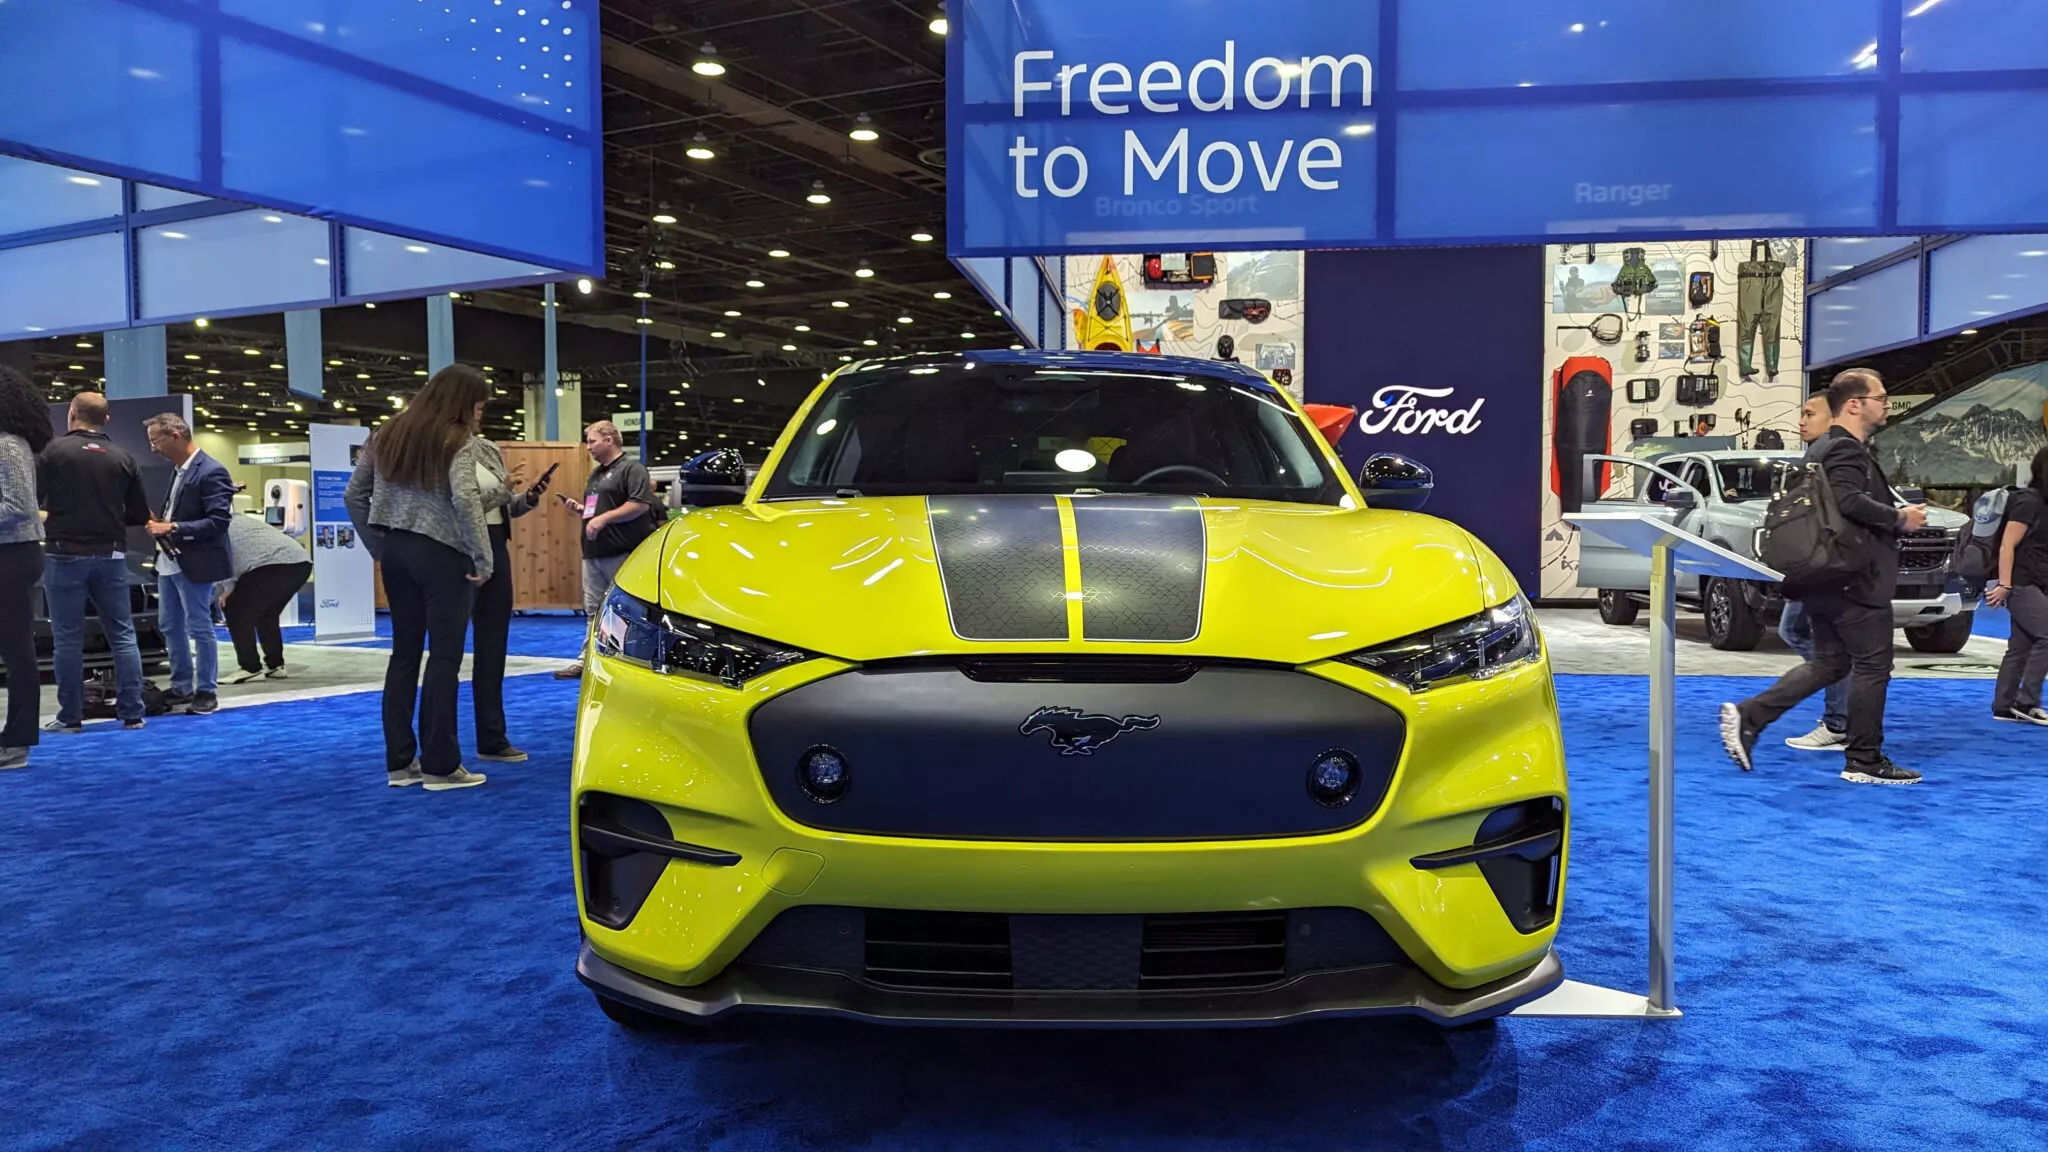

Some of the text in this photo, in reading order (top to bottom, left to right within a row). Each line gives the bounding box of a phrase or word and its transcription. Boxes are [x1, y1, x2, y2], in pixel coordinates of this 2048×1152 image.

[1013, 39, 1373, 117] Freedom
[1008, 127, 1342, 198] to Move
[1095, 193, 1259, 218] Bronco Sport
[1574, 182, 1673, 206] Ranger
[1359, 385, 1486, 435] Ford
[1892, 401, 1911, 410] GMC
[623, 417, 642, 426] HOND
